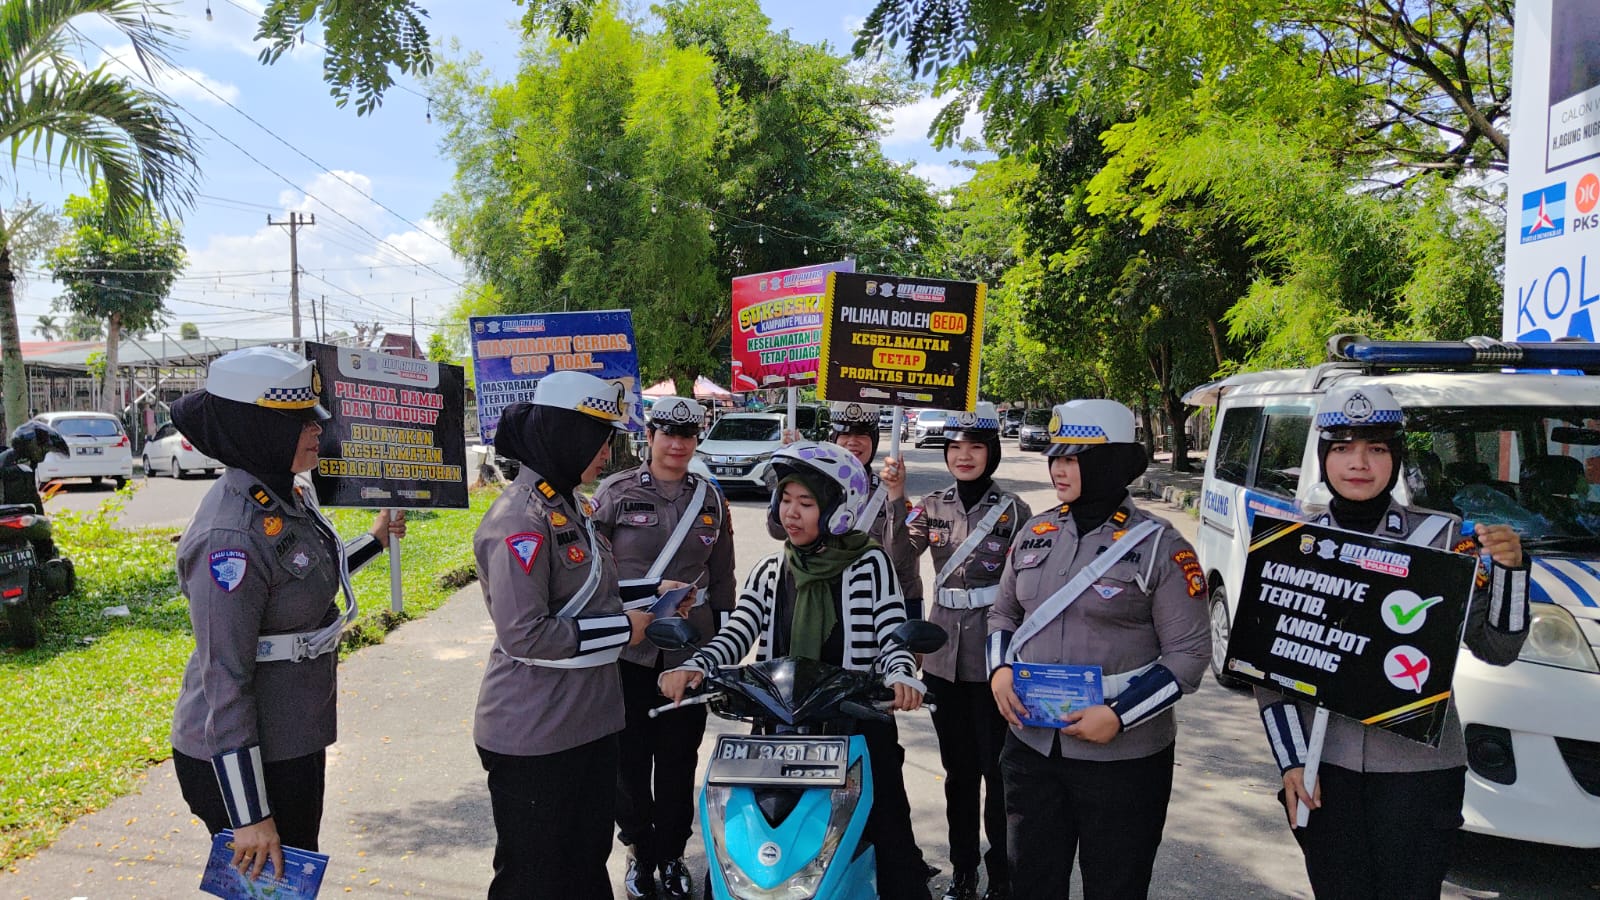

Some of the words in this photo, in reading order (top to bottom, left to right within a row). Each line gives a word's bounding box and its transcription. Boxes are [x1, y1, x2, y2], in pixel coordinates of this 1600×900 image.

[1562, 103, 1593, 124] CALON
[1552, 128, 1582, 150] H.AGUNG
[1573, 213, 1599, 233] PKS
[761, 316, 794, 332] KAMPANYE
[794, 314, 820, 326] PILKADA
[840, 306, 888, 326] PILIHAN
[891, 310, 930, 329] BOLEH
[933, 314, 964, 331] BEDA
[477, 336, 573, 359] MASYARAKAT
[573, 334, 632, 351] CERDAS,
[747, 330, 811, 353] KESELAMATAN
[852, 332, 950, 352] KESELAMATAN
[511, 355, 550, 374] STOP
[760, 350, 787, 365] TETAP
[878, 352, 920, 366] TETAP
[482, 380, 540, 393] MASYARAKA
[840, 366, 903, 382] PRORITAS
[908, 373, 954, 386] UTAMA
[335, 380, 398, 404] PILKADA
[400, 390, 444, 410] DAMAI
[484, 392, 516, 404] TERTIB
[342, 400, 372, 419] DAN
[375, 404, 440, 426] KONDUSIF
[351, 423, 434, 448] BUDAYAKAN
[342, 441, 443, 465] KESELAMATAN
[318, 458, 382, 478] SEBAGAI
[383, 462, 462, 482] KEBUTUHAN
[1020, 538, 1052, 550] RIZA
[1339, 542, 1411, 568] DITLANTAS
[1261, 561, 1370, 602] KAMPANYE
[1259, 584, 1328, 620] TERTIB,
[1276, 614, 1371, 656] KNALPOT
[1270, 637, 1342, 673] BRONG
[722, 744, 748, 760] BM
